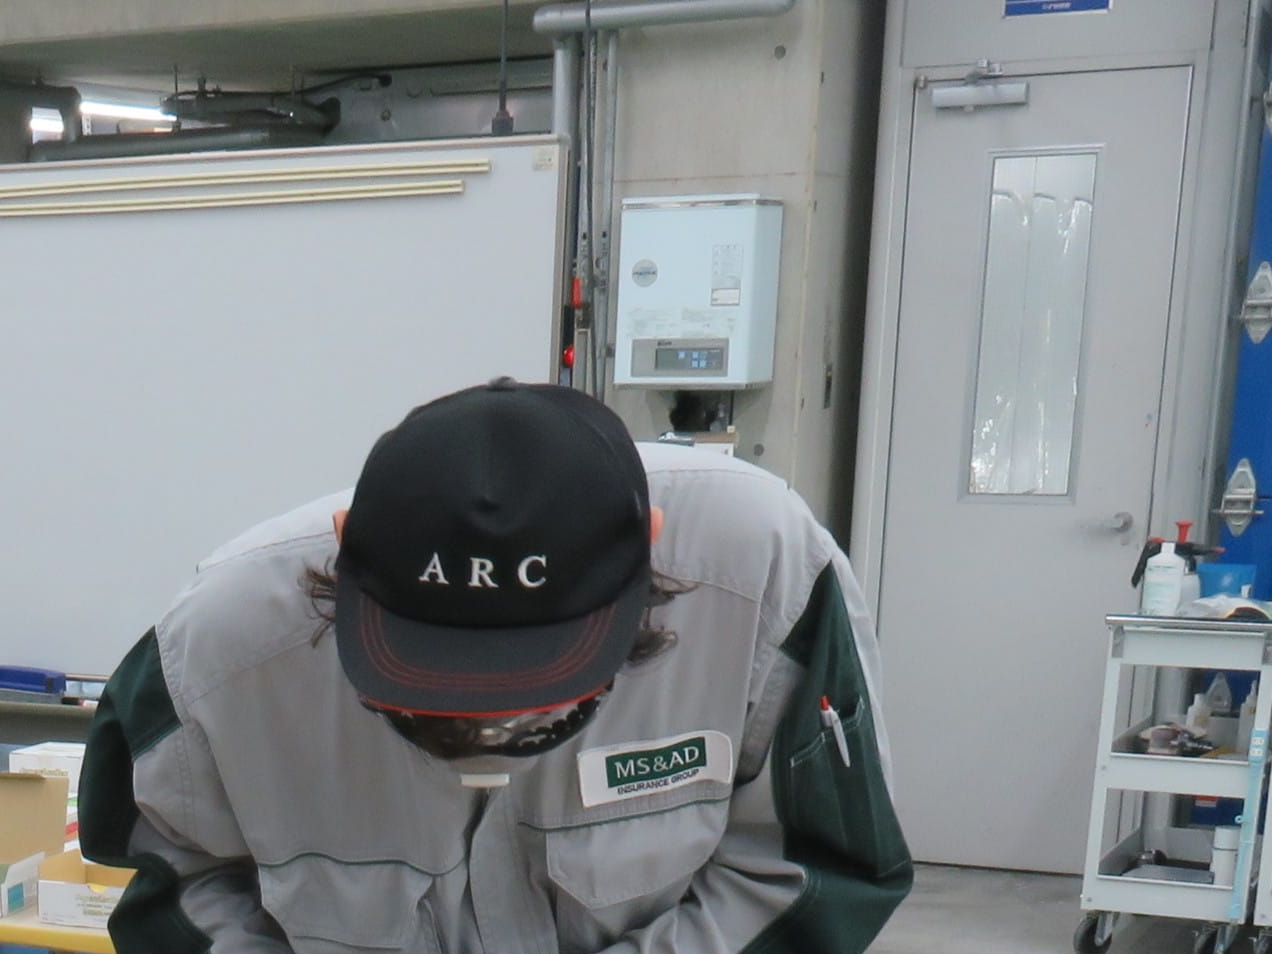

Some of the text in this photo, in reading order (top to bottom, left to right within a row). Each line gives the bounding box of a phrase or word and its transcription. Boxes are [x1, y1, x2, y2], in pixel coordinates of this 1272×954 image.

[418, 552, 548, 588] ARC
[613, 745, 700, 779] MS&AD
[616, 767, 700, 796] INSURANCE GROUP
